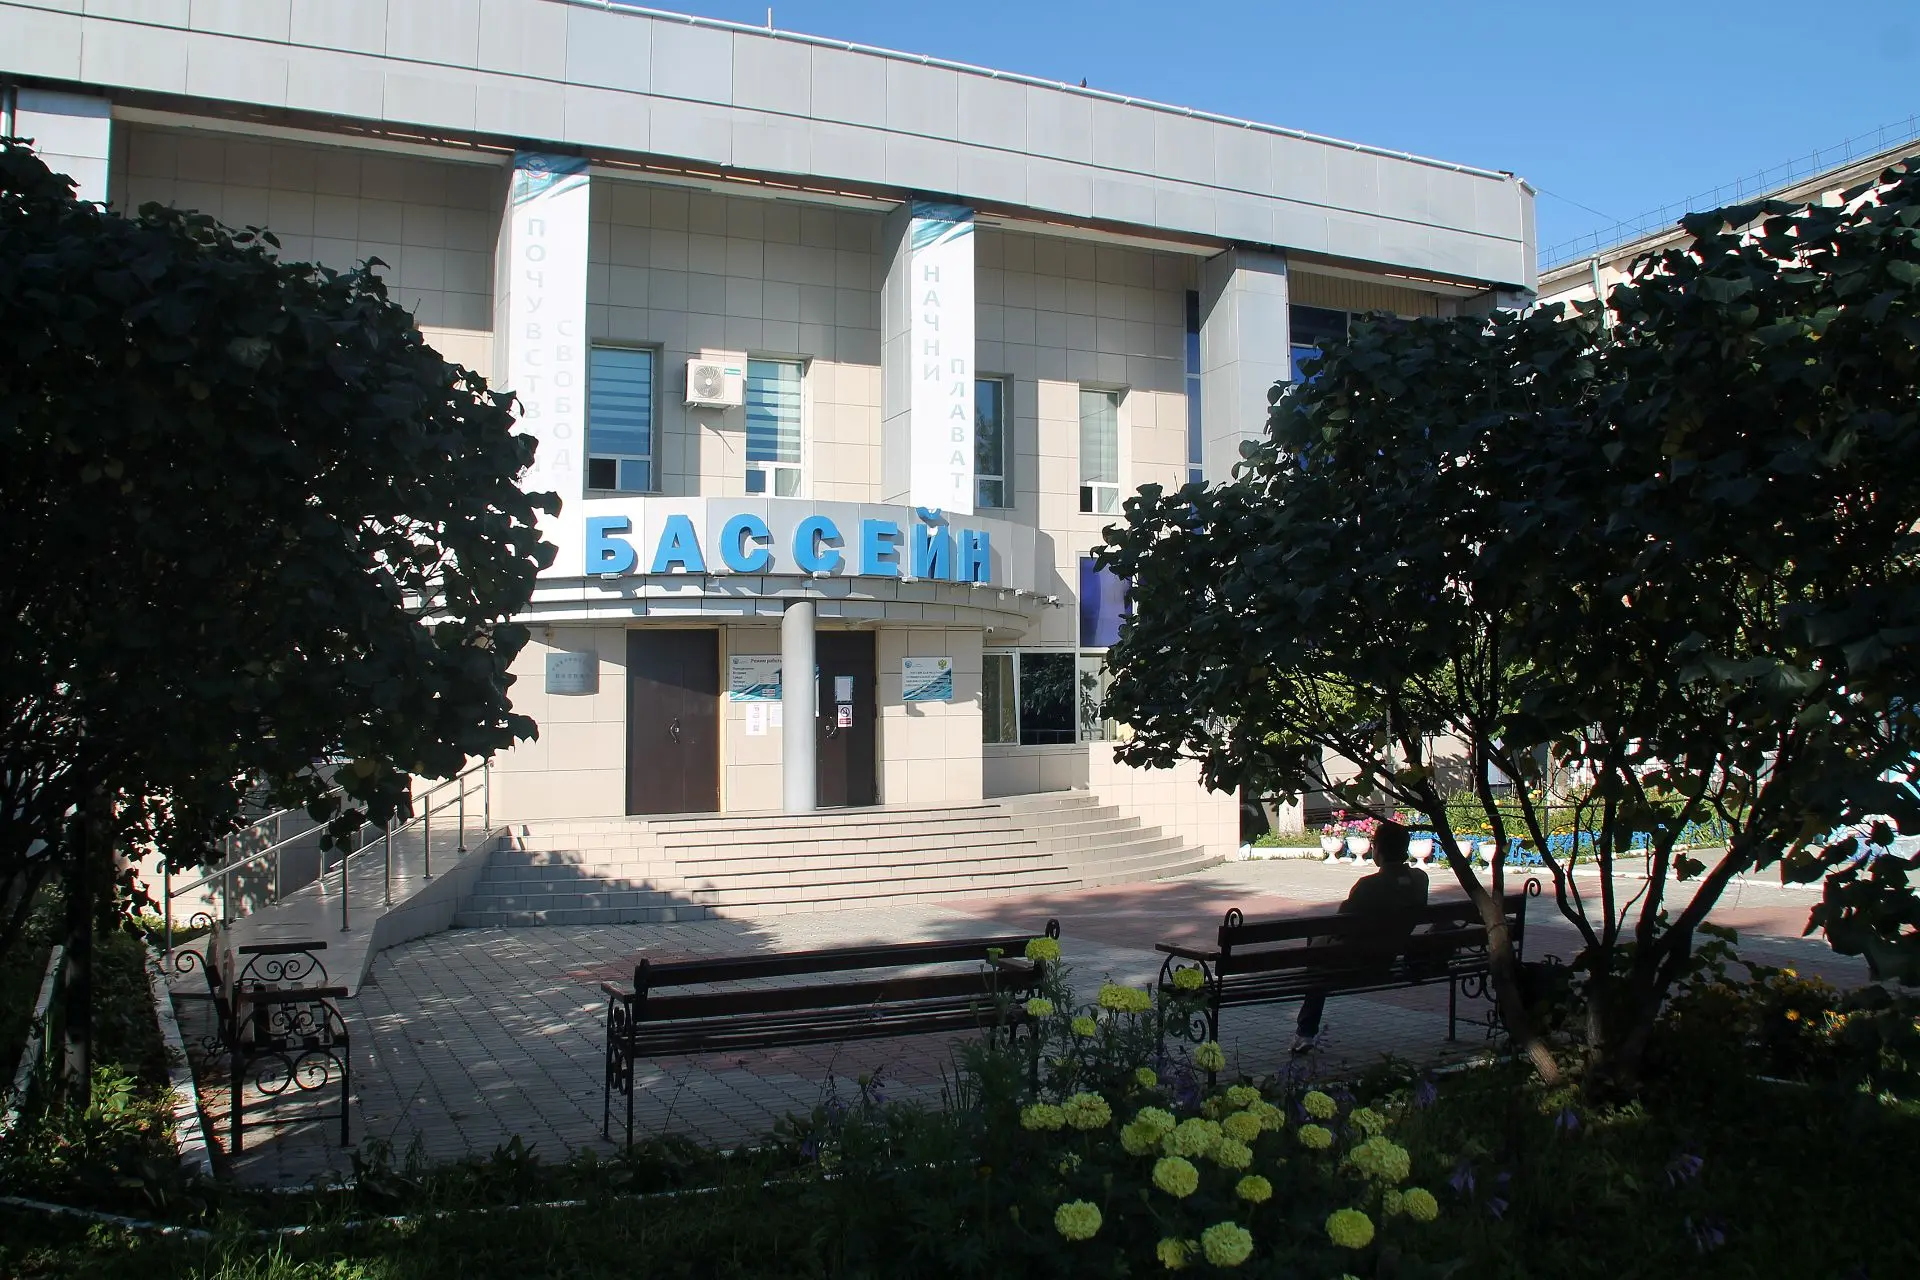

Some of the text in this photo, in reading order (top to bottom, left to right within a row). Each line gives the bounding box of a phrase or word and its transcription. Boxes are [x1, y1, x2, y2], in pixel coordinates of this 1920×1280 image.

[524, 216, 547, 472] ПОЧУВСТВ
[922, 264, 942, 382] НАЧНИ
[585, 507, 992, 583] БАССЕЙН
